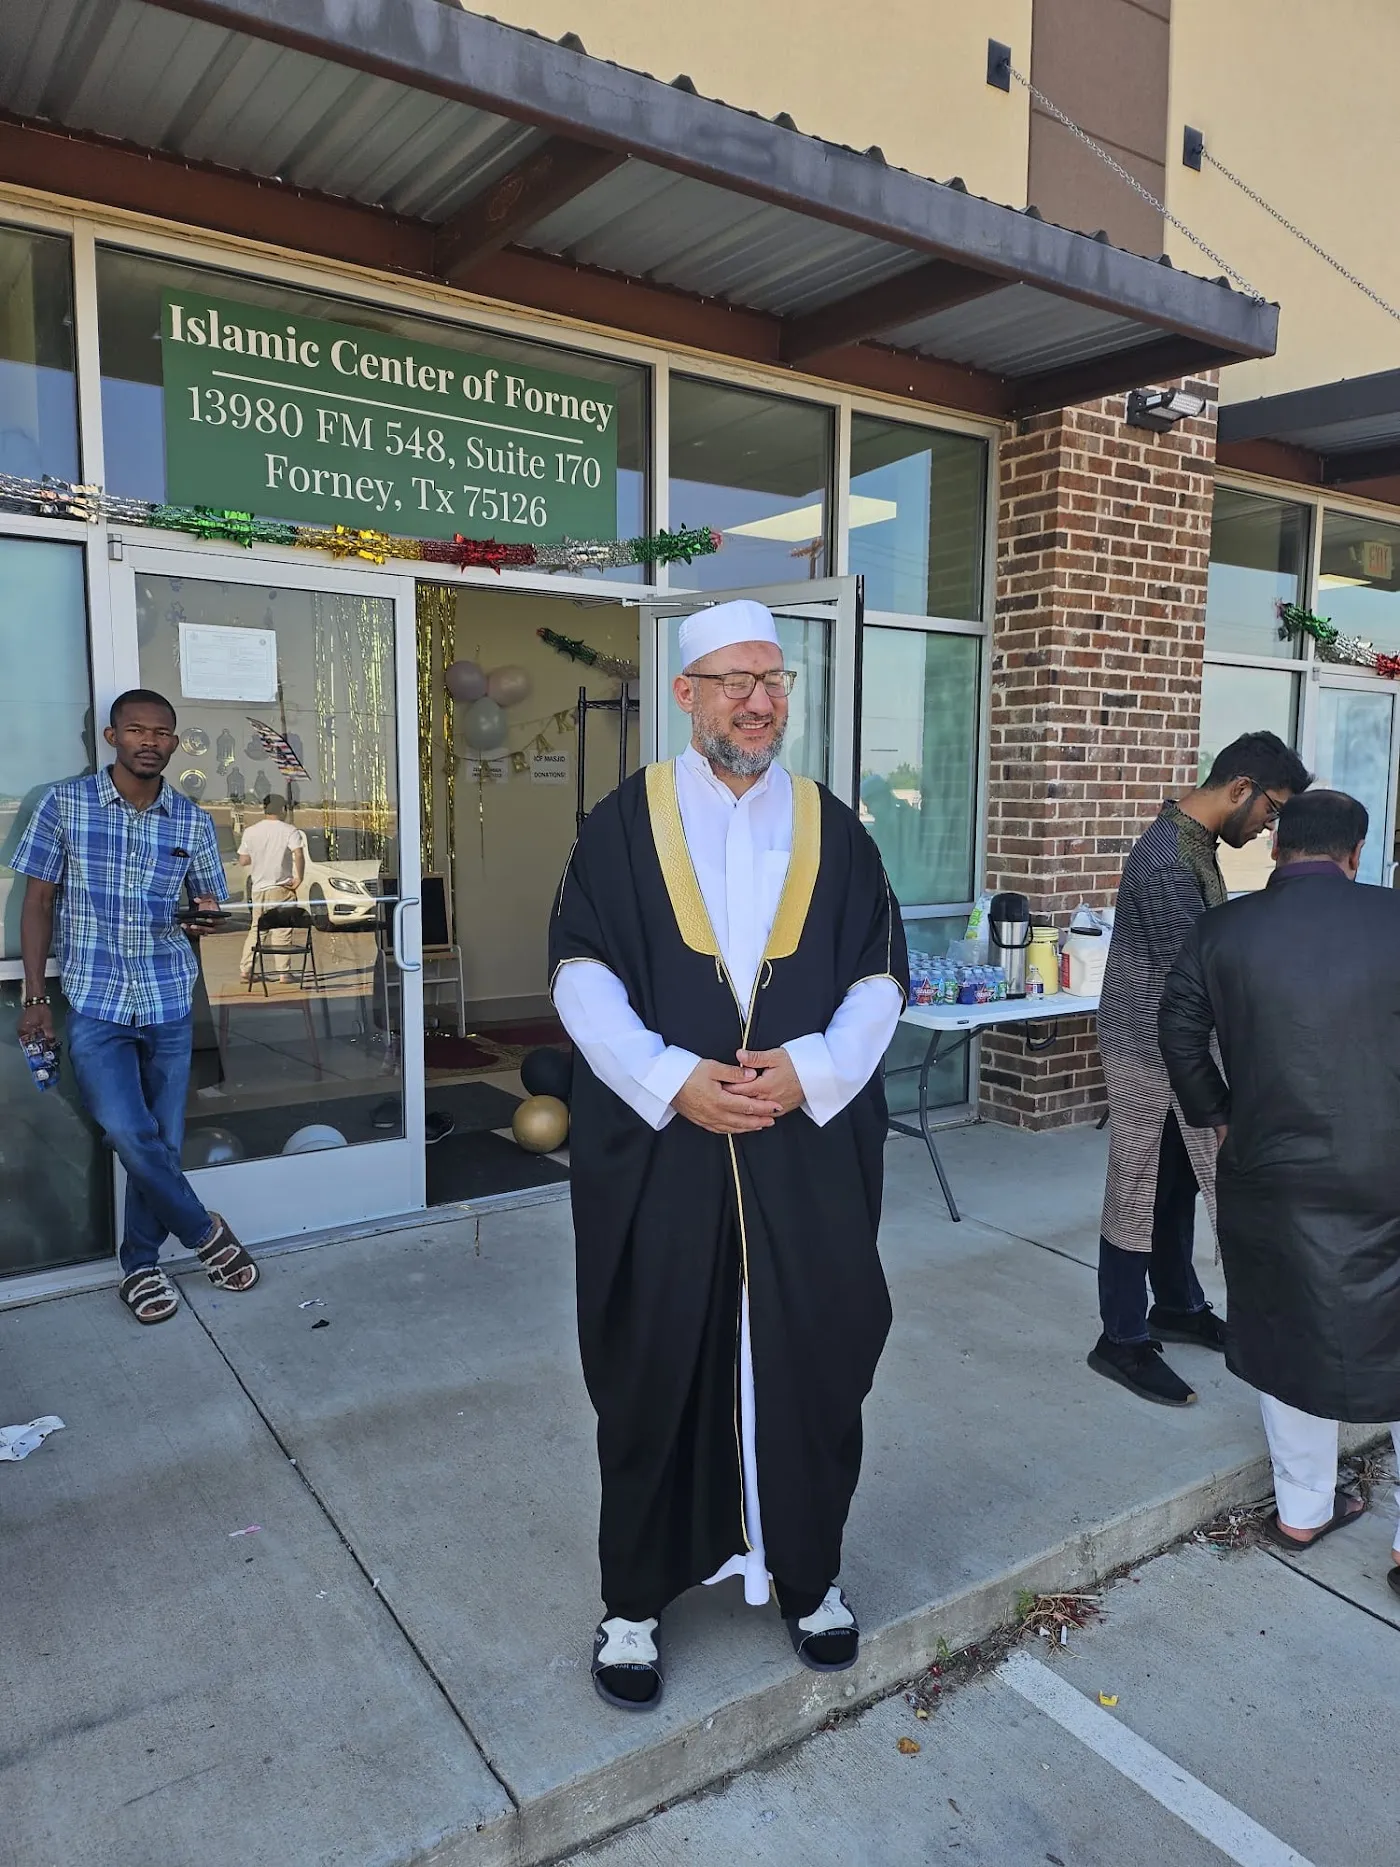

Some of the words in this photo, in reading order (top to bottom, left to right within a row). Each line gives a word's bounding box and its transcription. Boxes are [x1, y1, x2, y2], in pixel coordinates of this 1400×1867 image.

[168, 303, 320, 368] Islamic
[330, 340, 455, 395] Center
[462, 369, 499, 404] of
[504, 375, 614, 433] Forney
[187, 386, 304, 439] 13980
[315, 408, 375, 451] FM
[385, 421, 456, 470] 548,
[466, 436, 546, 480] Suite
[554, 452, 601, 489] 170
[264, 452, 403, 512] Forney,
[411, 476, 455, 515] Tx
[463, 484, 547, 528] 75126
